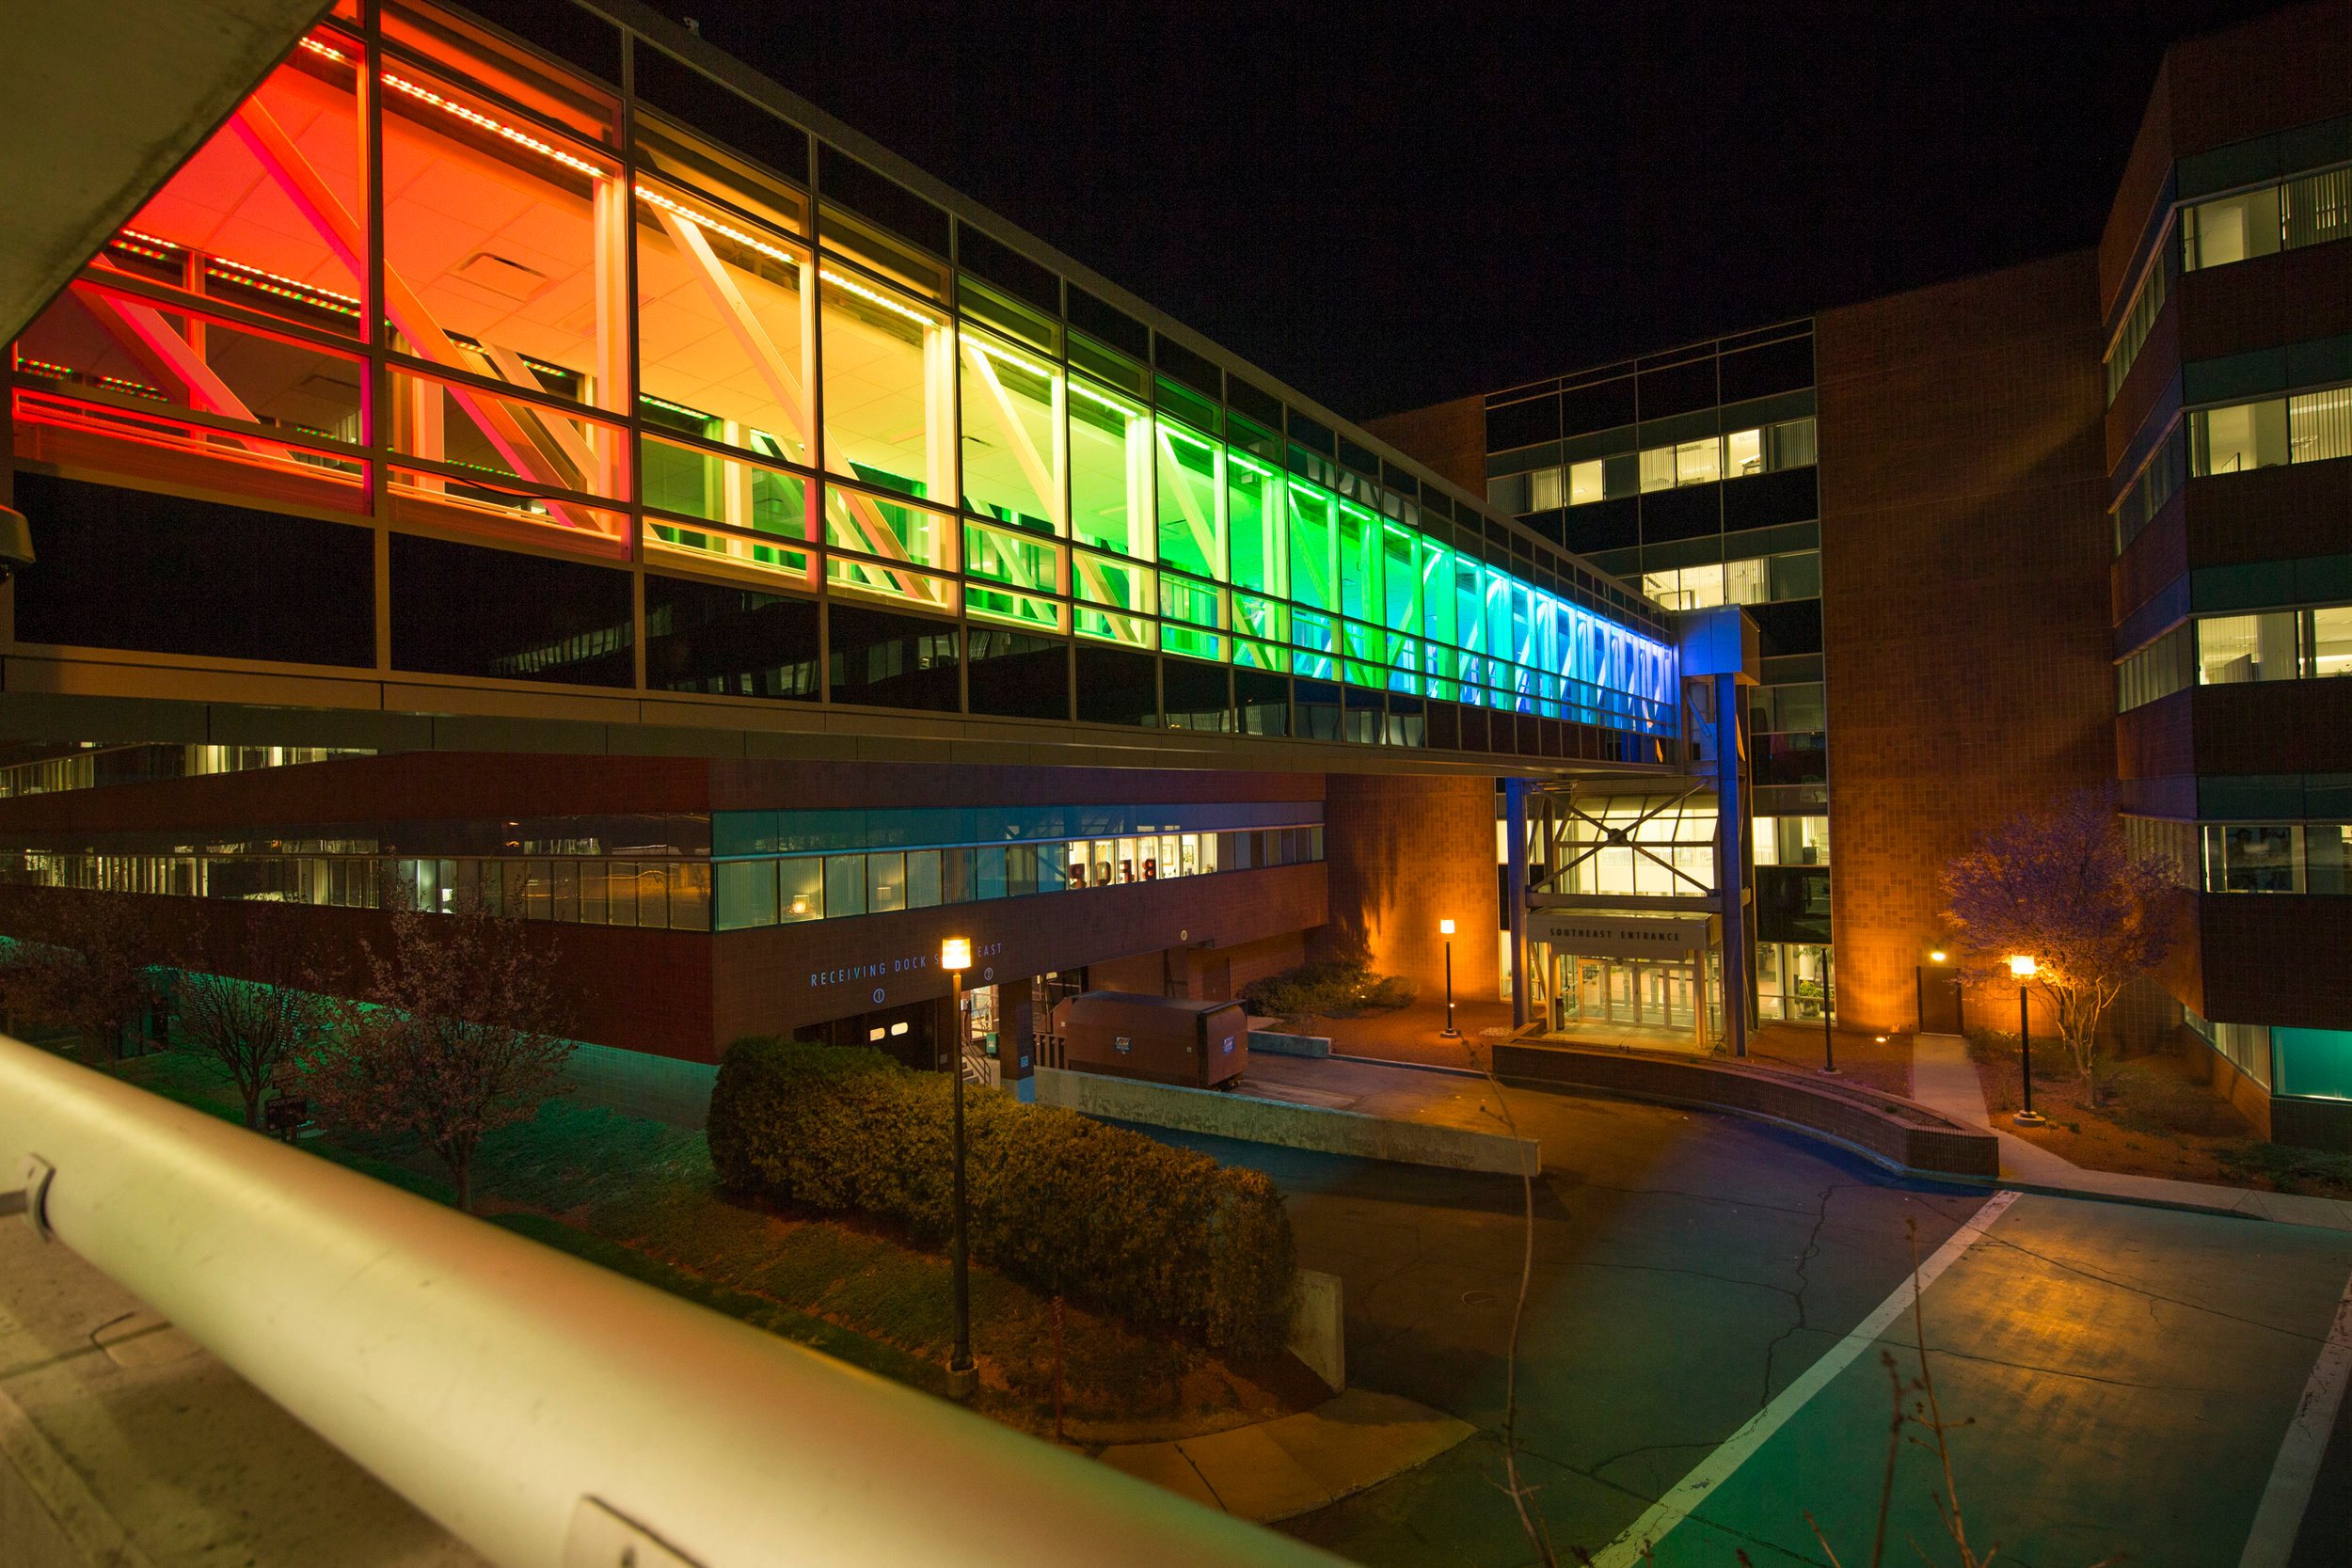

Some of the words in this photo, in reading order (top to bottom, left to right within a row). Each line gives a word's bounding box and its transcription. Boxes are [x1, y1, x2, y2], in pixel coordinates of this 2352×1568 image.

[1549, 927, 1612, 939] SOUTHEAST
[1620, 931, 1679, 942] ENTRANCE
[810, 962, 885, 987] RECEIVING
[895, 955, 927, 973] DOCK
[933, 942, 1002, 966] SEAST
